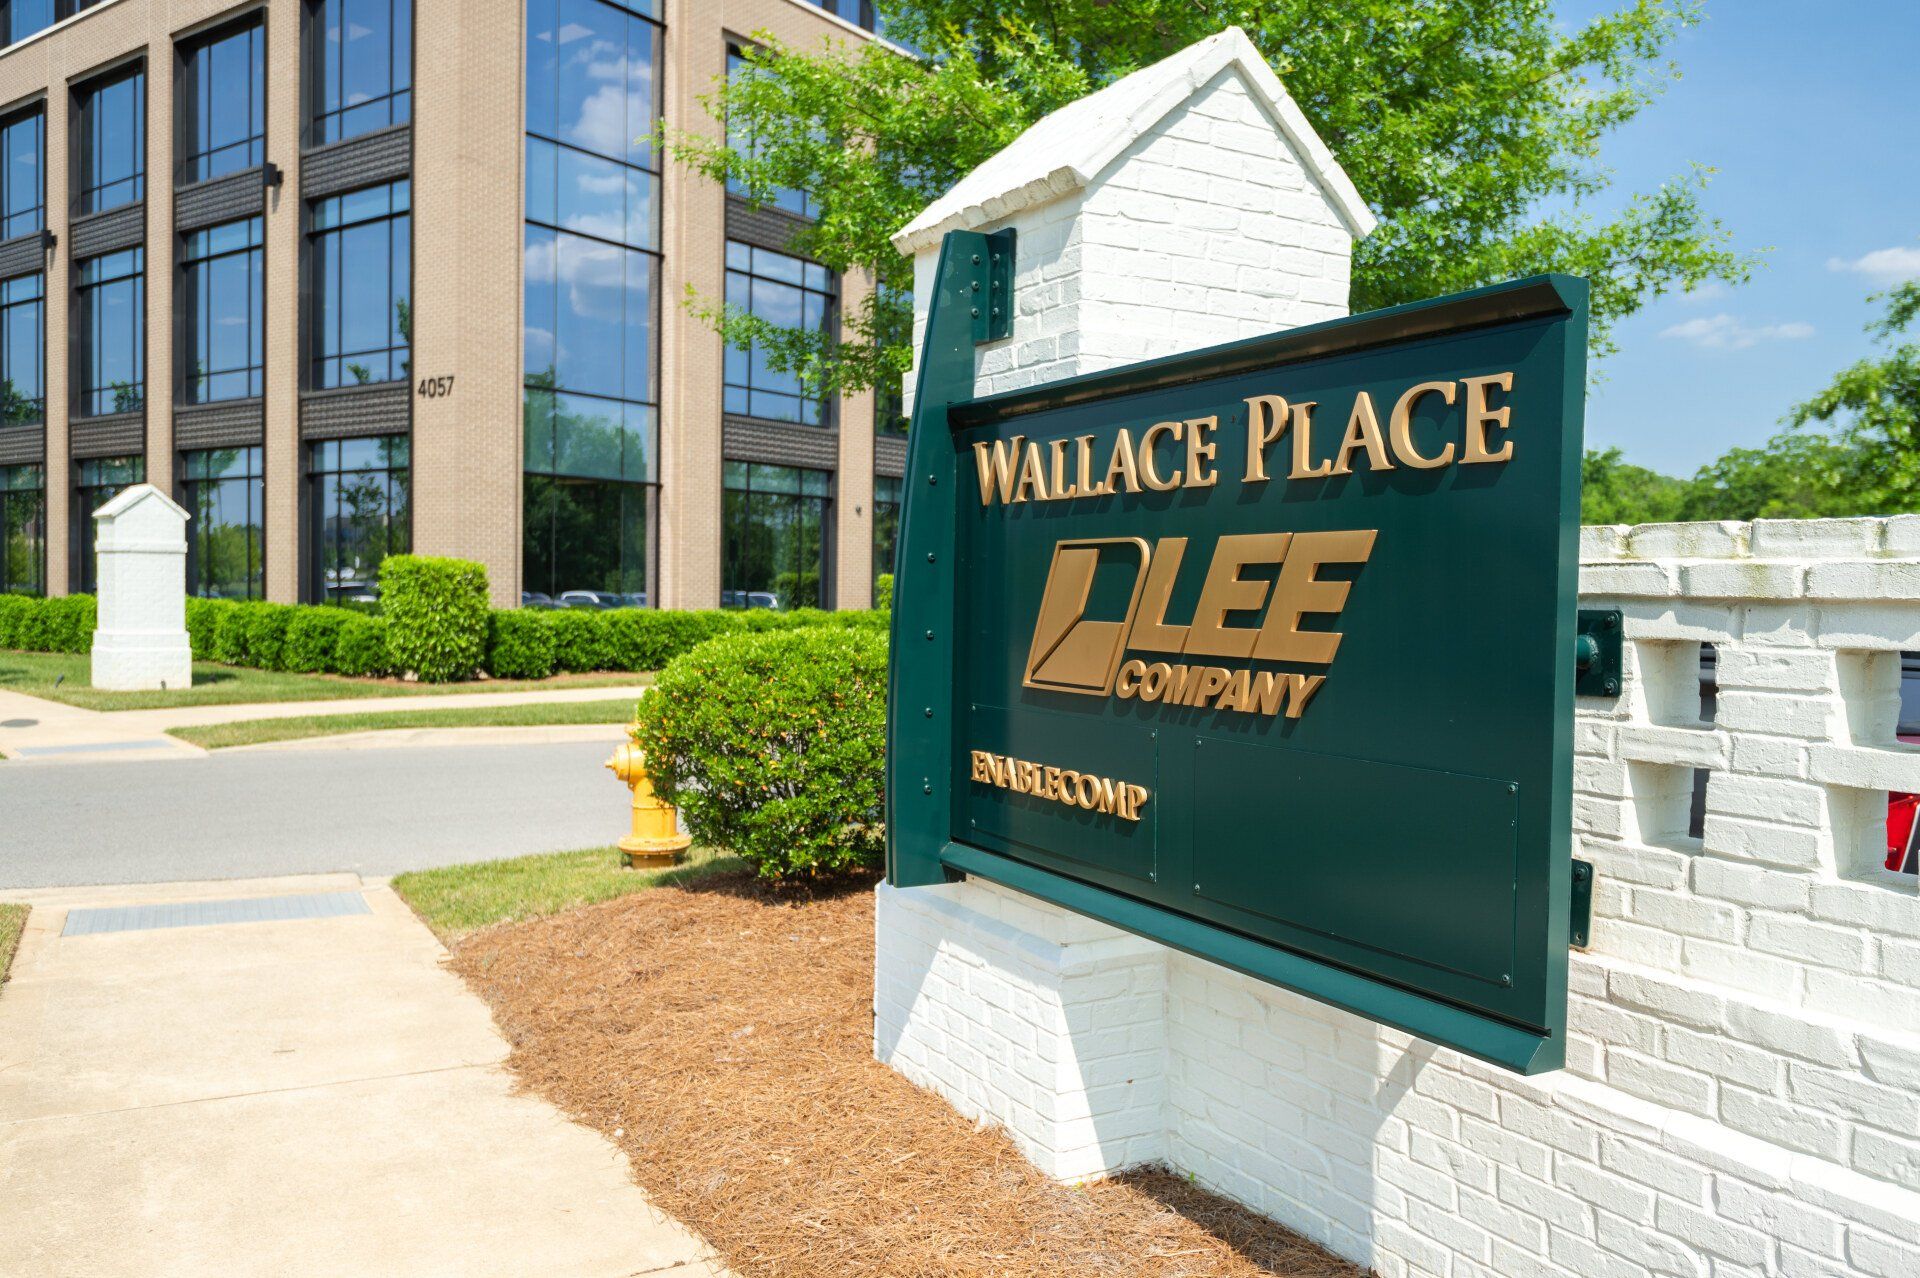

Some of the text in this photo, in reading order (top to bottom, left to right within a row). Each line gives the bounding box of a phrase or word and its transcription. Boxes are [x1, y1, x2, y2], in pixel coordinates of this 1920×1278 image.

[418, 376, 454, 398] 4057
[972, 372, 1514, 506] WALLACE PLACE
[1126, 529, 1378, 664] LEE
[1115, 660, 1326, 719] COMPANY
[970, 750, 1148, 821] ENABLECOMP
